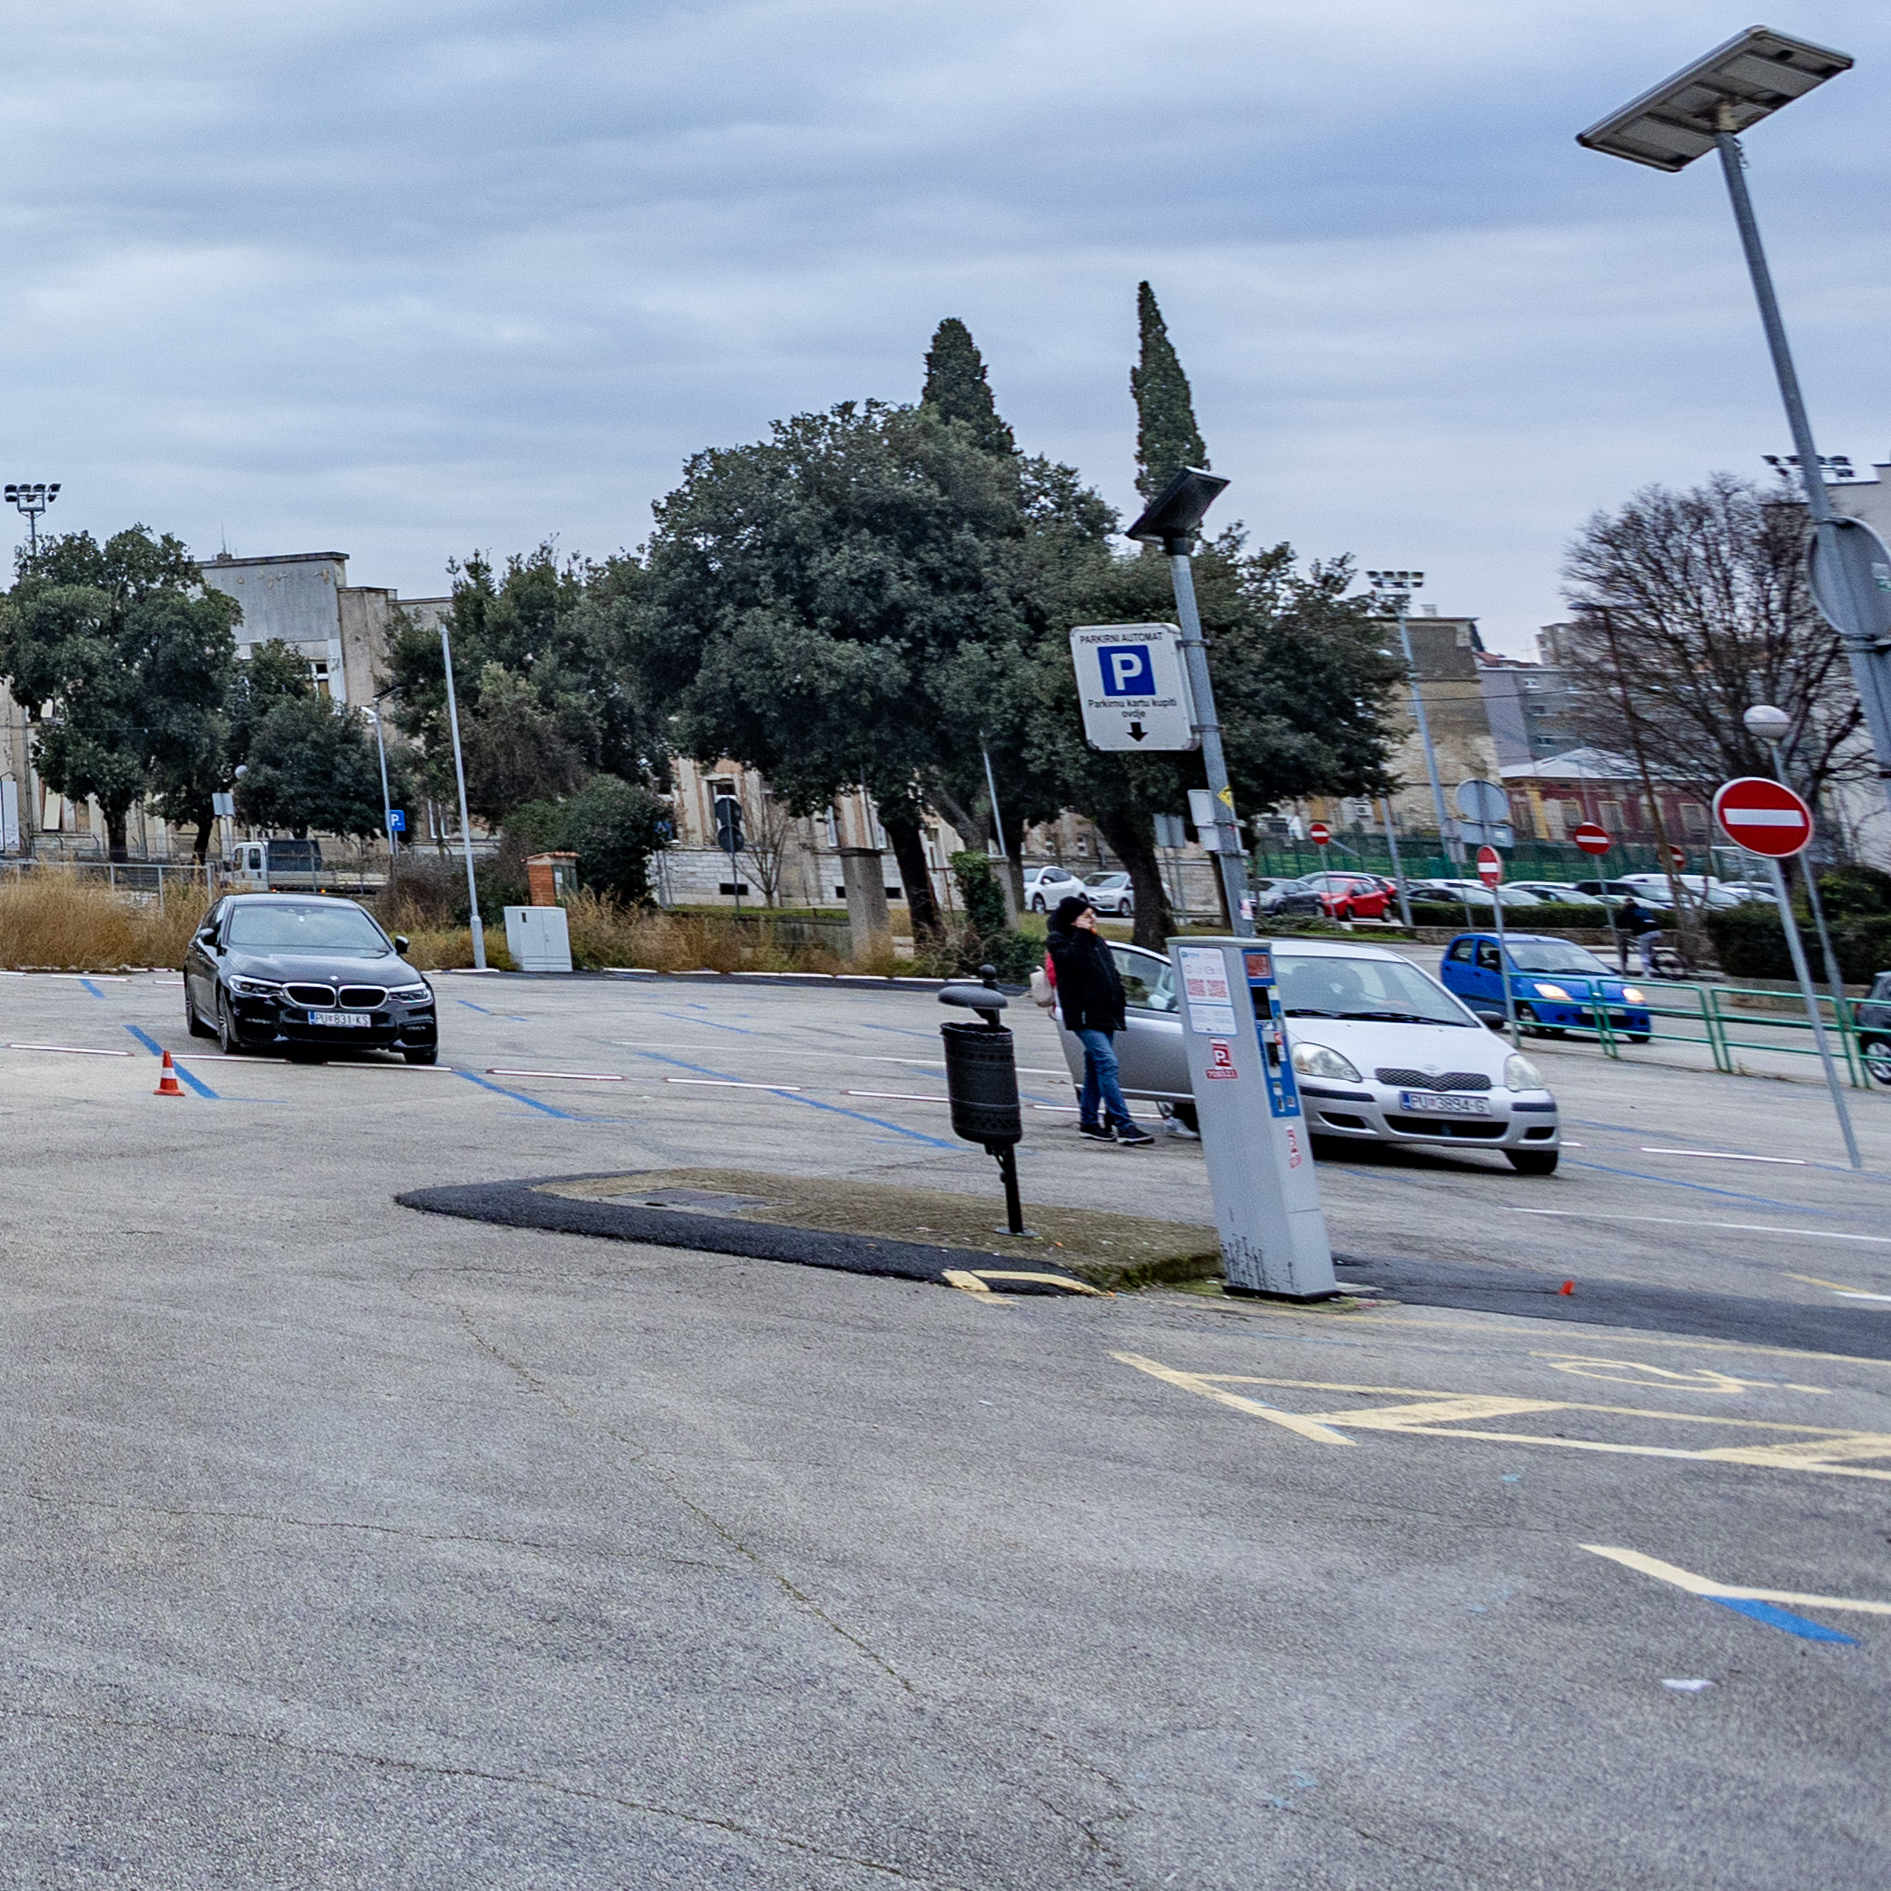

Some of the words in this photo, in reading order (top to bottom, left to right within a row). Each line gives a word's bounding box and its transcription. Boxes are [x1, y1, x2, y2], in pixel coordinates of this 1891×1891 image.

[1080, 634, 1120, 644] PARKIRNI
[1122, 631, 1163, 643] AUTOMAT
[1110, 652, 1143, 691] P
[1088, 698, 1125, 708] Parkirnu
[1127, 698, 1150, 708] kartu
[1152, 697, 1177, 710] kupiti
[1121, 709, 1146, 720] ovdje
[391, 813, 399, 827] P
[316, 1013, 328, 1024] PU
[334, 1014, 369, 1026] 831-KS
[1410, 1095, 1427, 1109] PU
